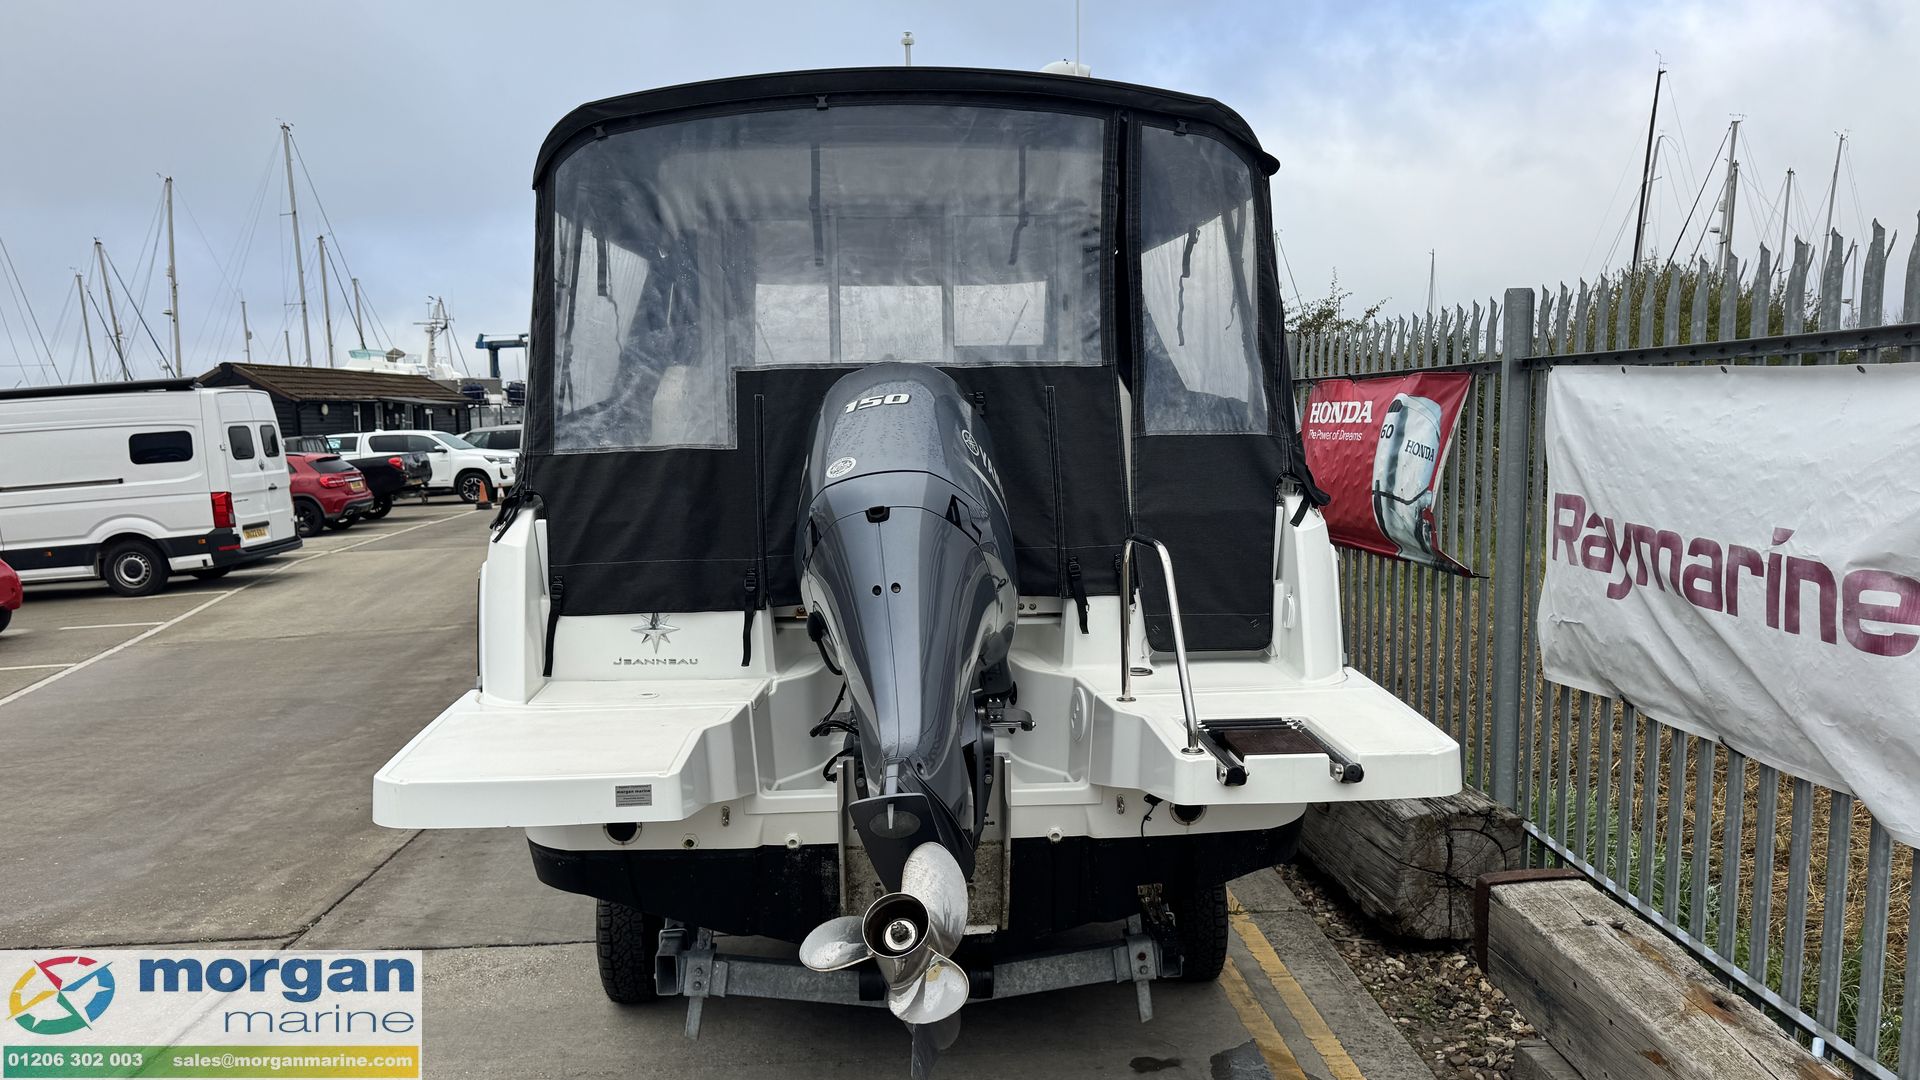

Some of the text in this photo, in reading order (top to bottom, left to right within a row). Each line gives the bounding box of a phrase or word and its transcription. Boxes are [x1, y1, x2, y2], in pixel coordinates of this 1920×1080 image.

[845, 393, 910, 414] 150
[1309, 401, 1373, 424] HONDA
[1317, 430, 1333, 440] Power
[1339, 430, 1363, 441] Dreams
[1380, 424, 1394, 439] 60
[1405, 440, 1435, 462] HONDA
[612, 657, 698, 665] JEANNEAU
